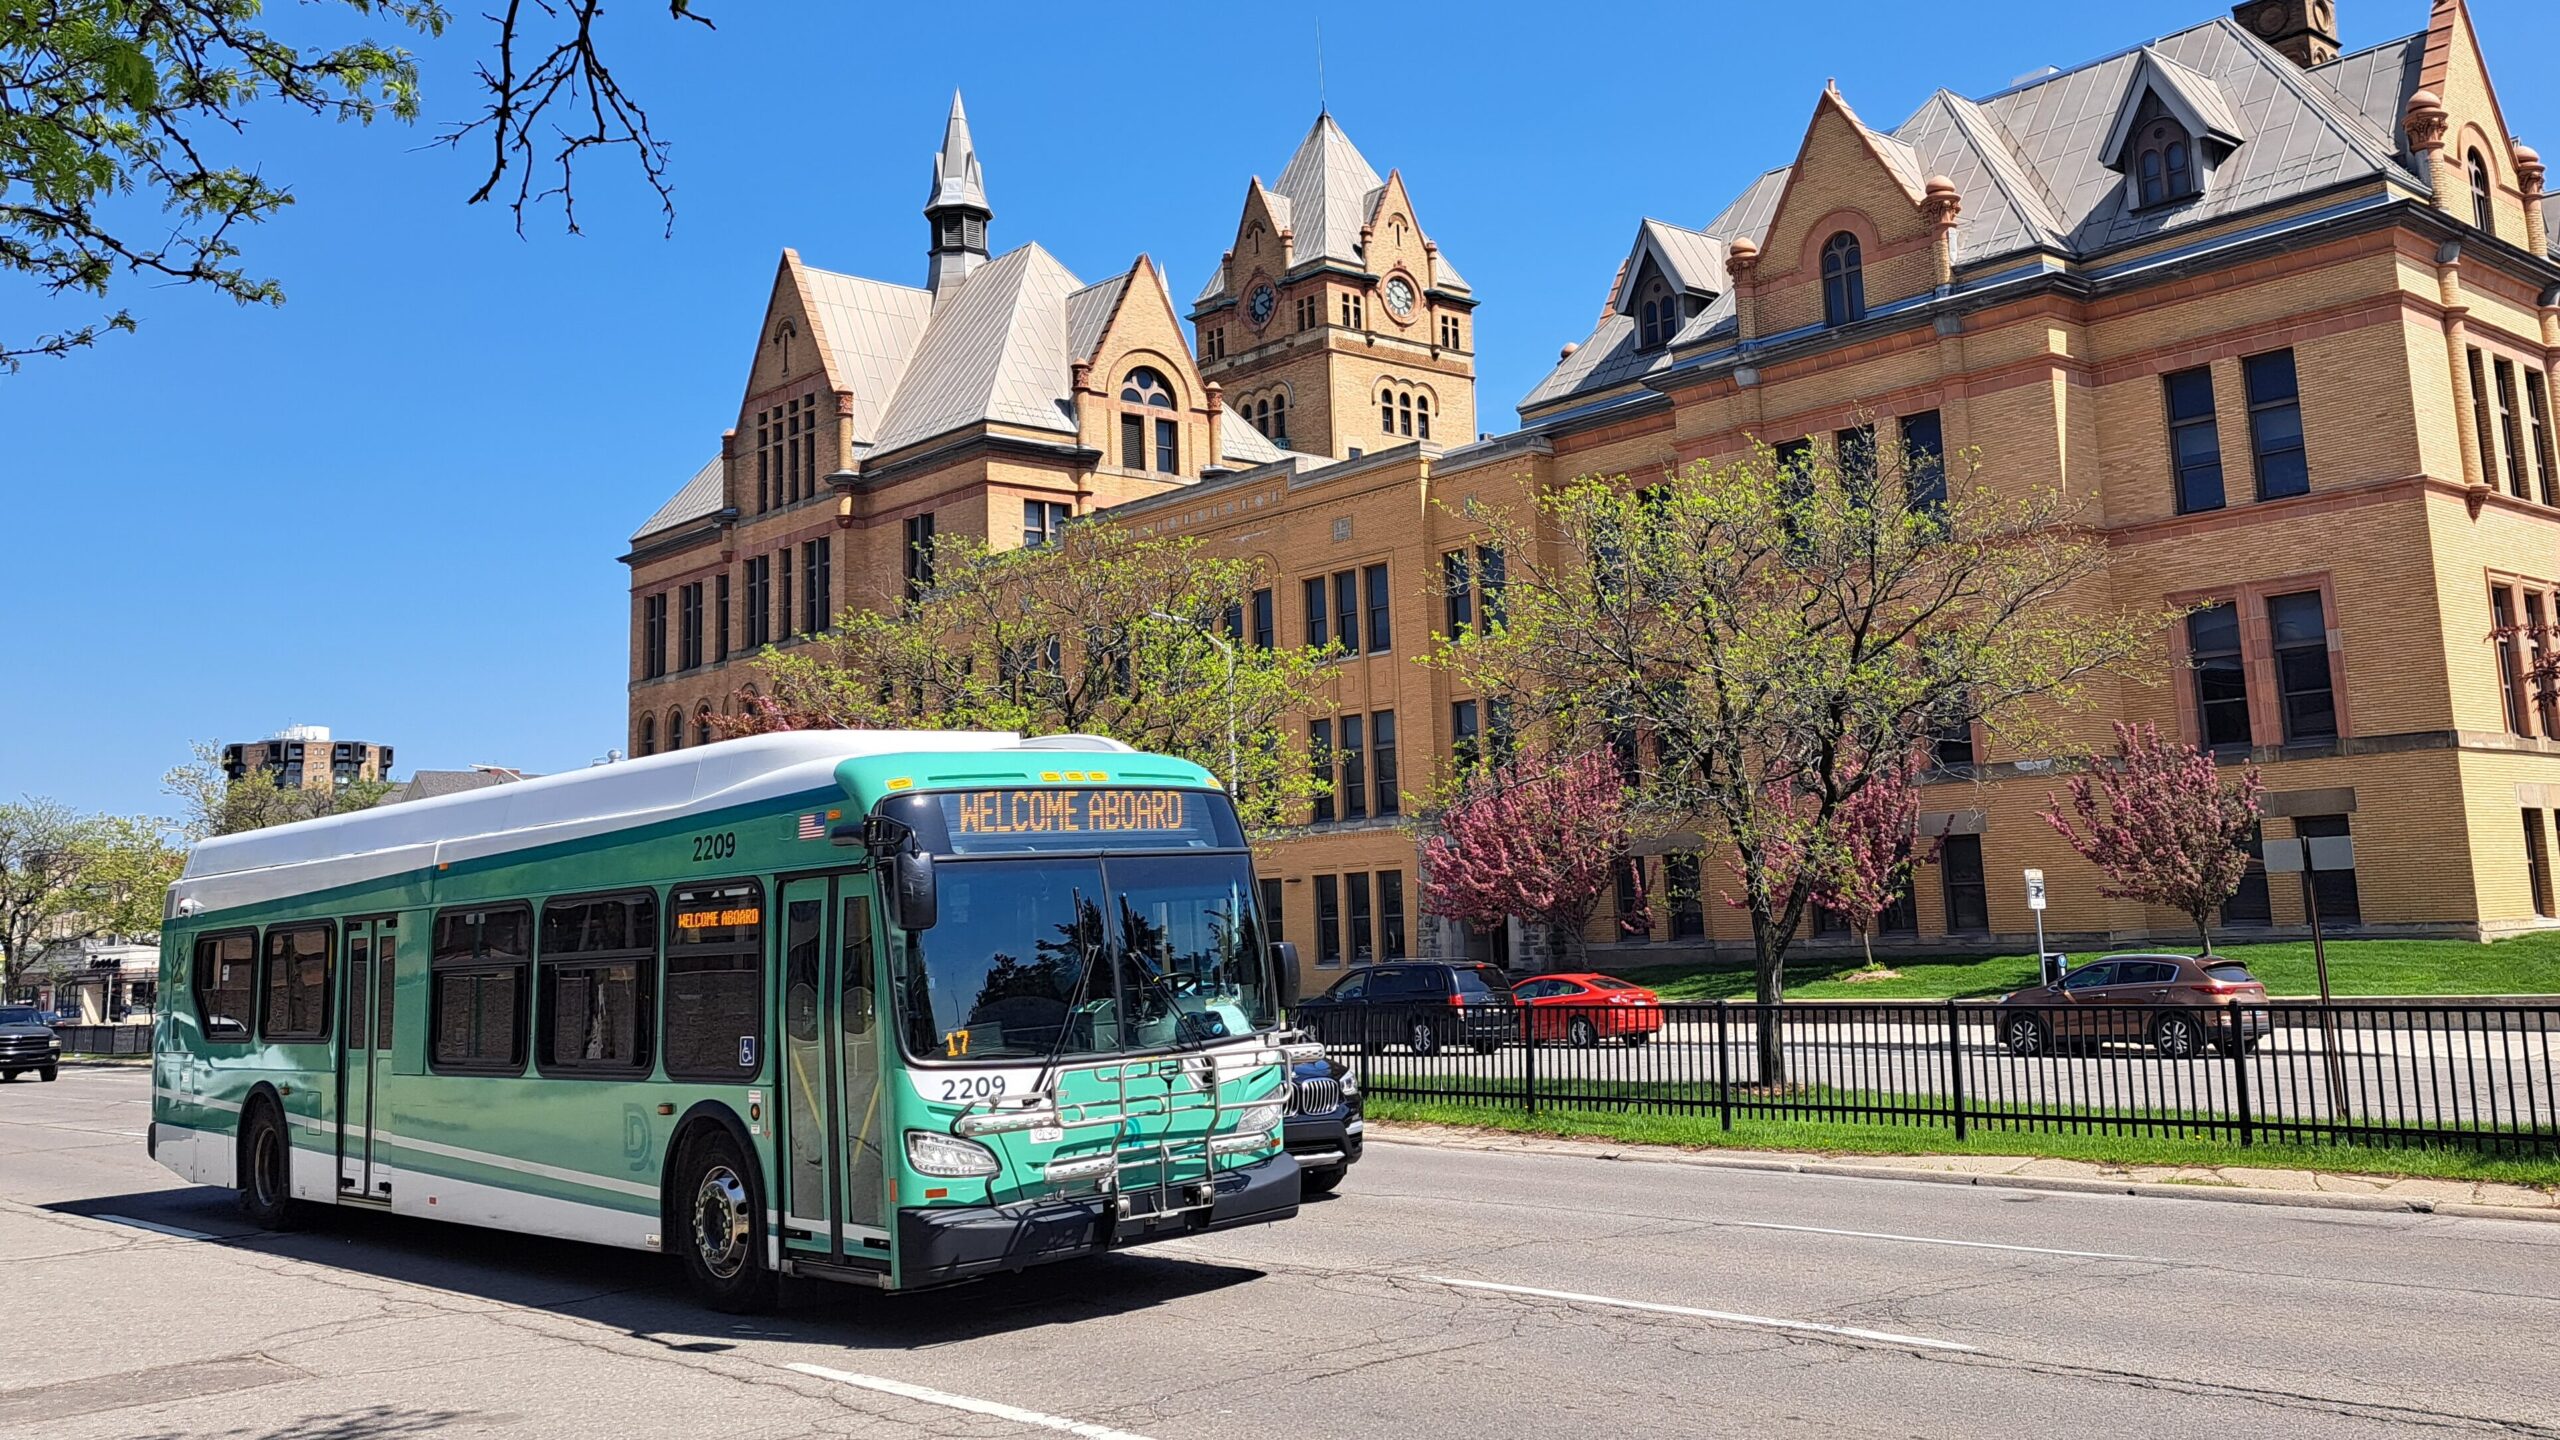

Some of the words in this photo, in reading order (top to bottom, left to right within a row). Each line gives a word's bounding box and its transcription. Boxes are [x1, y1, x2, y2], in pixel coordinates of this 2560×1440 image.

[960, 791, 1079, 832] WELCOME
[1088, 791, 1183, 830] ABOARD
[692, 832, 736, 862] 2209
[678, 911, 718, 929] WELCOME
[721, 908, 759, 926] ABOARD
[946, 1030, 971, 1057] 17
[942, 1075, 1006, 1100] 2209
